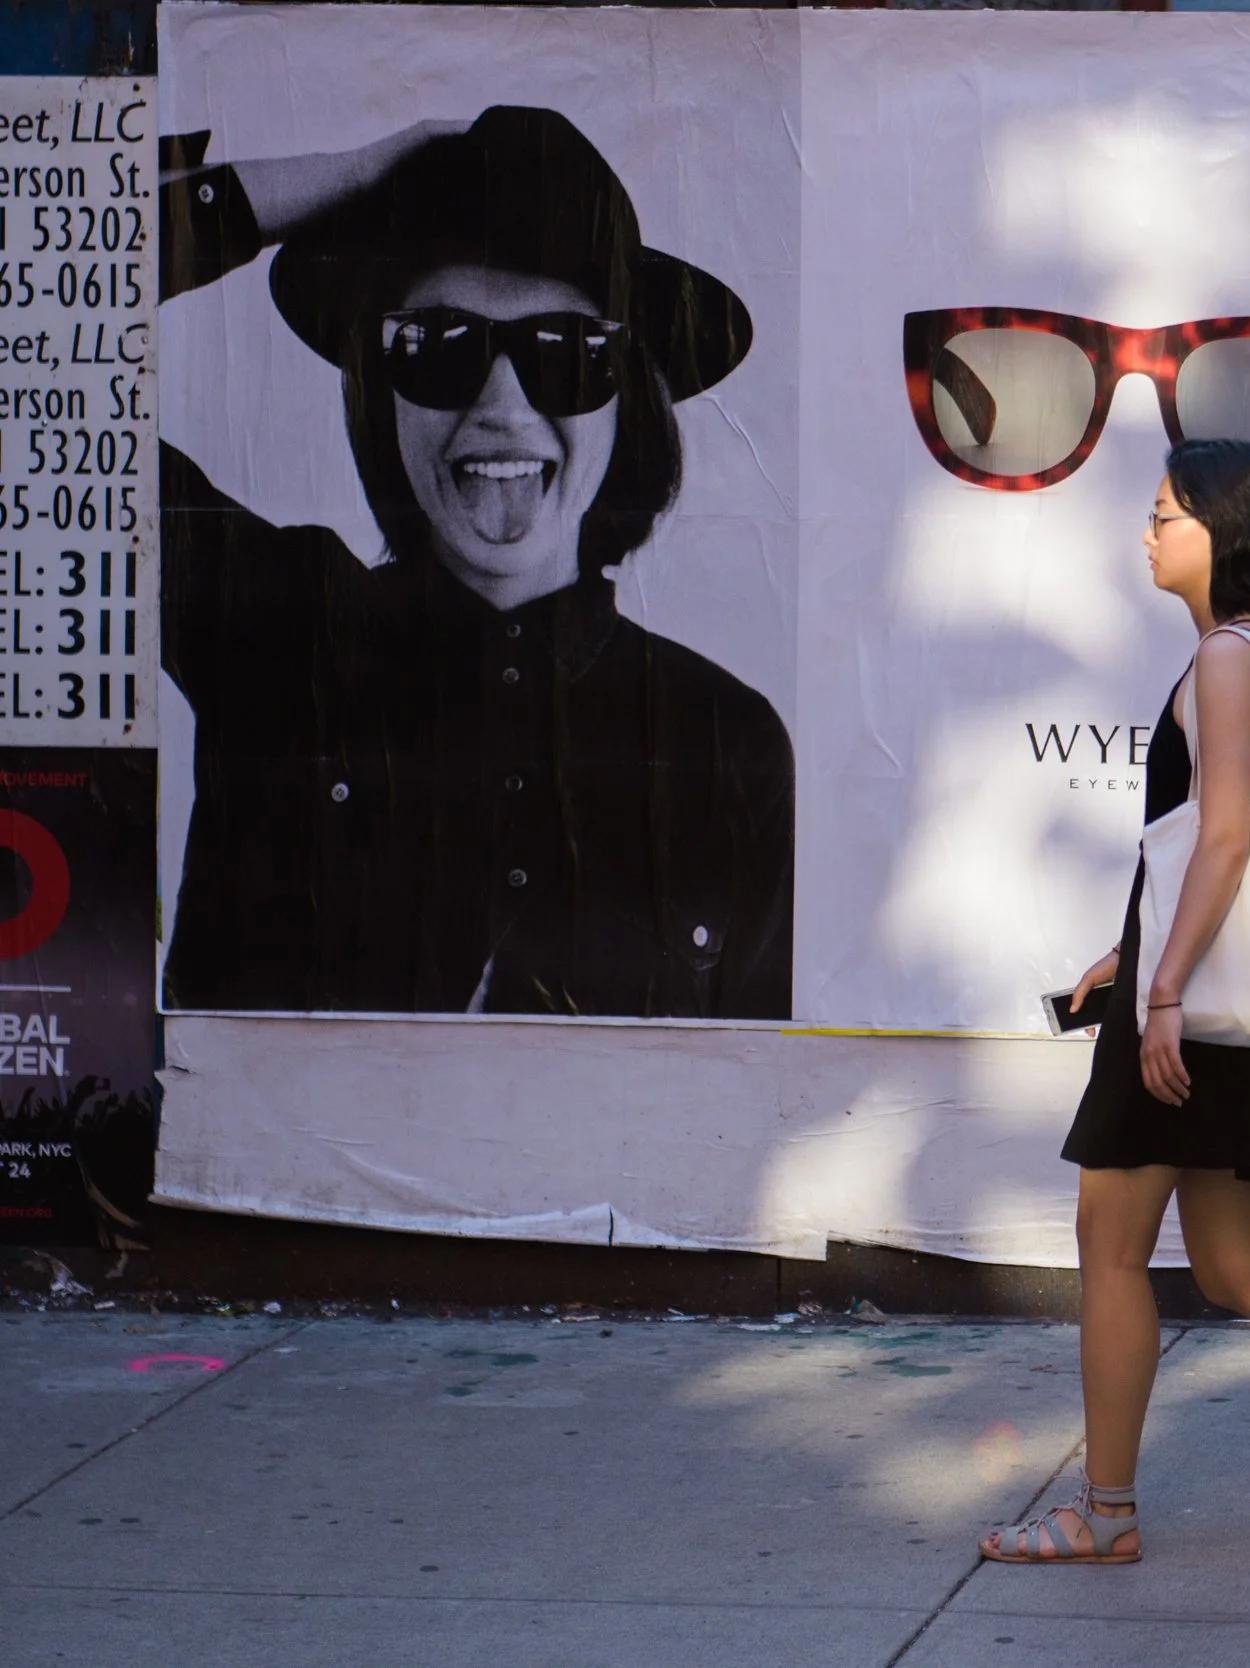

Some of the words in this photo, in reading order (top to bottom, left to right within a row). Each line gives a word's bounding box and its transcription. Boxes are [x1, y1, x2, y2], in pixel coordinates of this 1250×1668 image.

[71, 101, 146, 143] LLC
[110, 153, 150, 198] St.
[33, 207, 143, 251] 53202
[0, 263, 141, 308] 65-0615
[71, 324, 148, 364] LLC
[110, 375, 150, 420] St.
[28, 430, 138, 474] 53202
[59, 550, 137, 598] 311
[58, 609, 136, 656] 311
[58, 672, 136, 719] 311
[0, 772, 87, 787] OVEMENT
[1070, 779, 1139, 790] EYEW
[0, 1013, 70, 1044] BAL
[9, 1162, 31, 1178] 24
[39, 1143, 71, 1157] NYC
